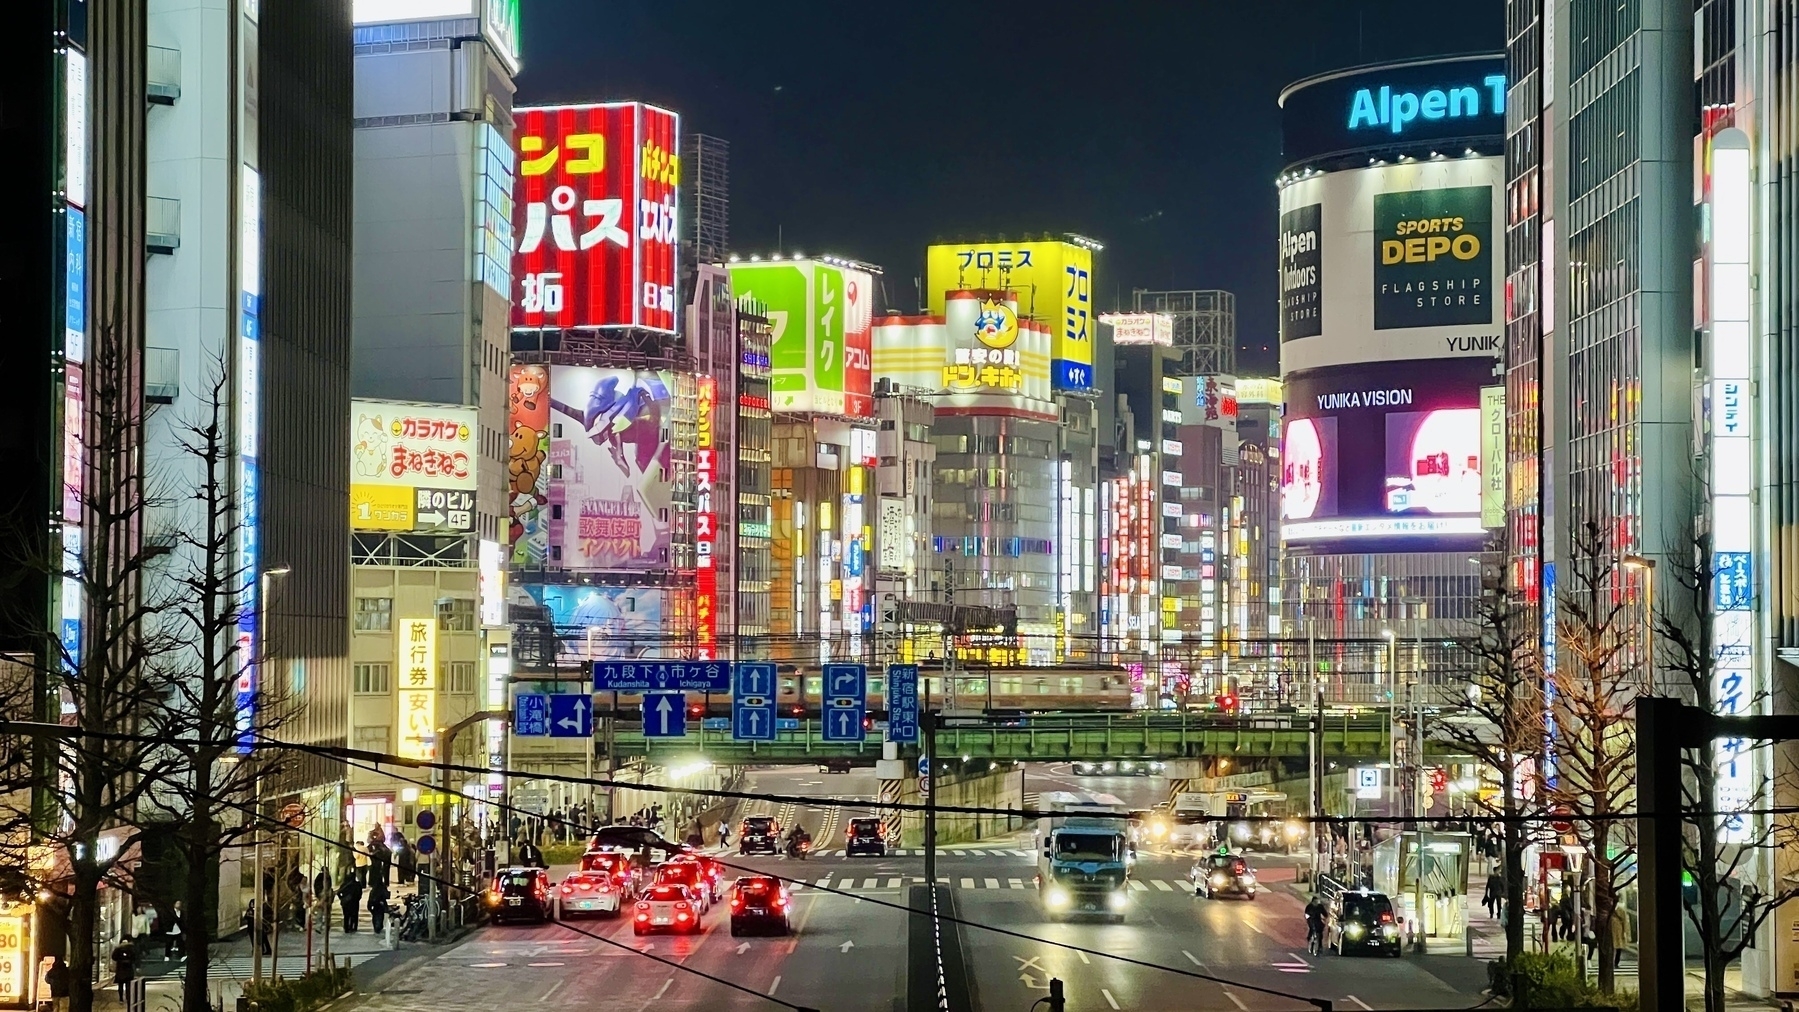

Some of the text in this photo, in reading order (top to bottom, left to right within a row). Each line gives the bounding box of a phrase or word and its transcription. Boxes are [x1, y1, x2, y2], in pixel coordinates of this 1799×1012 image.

[1349, 85, 1479, 133] Alpen
[521, 134, 604, 176] ンコ
[641, 139, 681, 185] パチンコ
[519, 186, 628, 253] パス
[640, 194, 677, 244] エスパス
[1396, 217, 1464, 235] SPORTS
[1282, 228, 1316, 262] Alpen
[1382, 234, 1481, 265] DEPO
[957, 250, 1033, 268] プロミス
[1284, 264, 1316, 292] Outdoors
[1382, 279, 1481, 294] FLAGSHIP
[1284, 292, 1317, 310] FLAGSHIP
[1417, 295, 1481, 308] STORE
[821, 273, 835, 372] レイク
[1290, 307, 1317, 322] STORE
[1447, 335, 1505, 352] YUNIK
[845, 346, 870, 371] アコム
[854, 400, 862, 413] 3F
[1317, 388, 1412, 410] YUNIKA VISION
[1487, 395, 1505, 405] THE
[699, 385, 711, 446] パチンコ
[402, 417, 458, 440] カラオケ
[390, 443, 470, 479] まねきねこ
[1491, 408, 1502, 491] グローバル社
[418, 490, 473, 510] 隣のビル
[698, 451, 711, 534] エスパス
[450, 513, 468, 526] 4F
[579, 518, 641, 537] 歌舞伎町
[578, 538, 641, 557] インパクト
[410, 621, 427, 686] 旅行券
[604, 664, 653, 679] 九段下
[608, 680, 649, 688] Kudanshita
[680, 680, 711, 688] Ichigaya
[891, 670, 901, 704] Shinjuku
[902, 668, 914, 737] 新宿駅東口
[529, 697, 543, 734] 小滝橋
